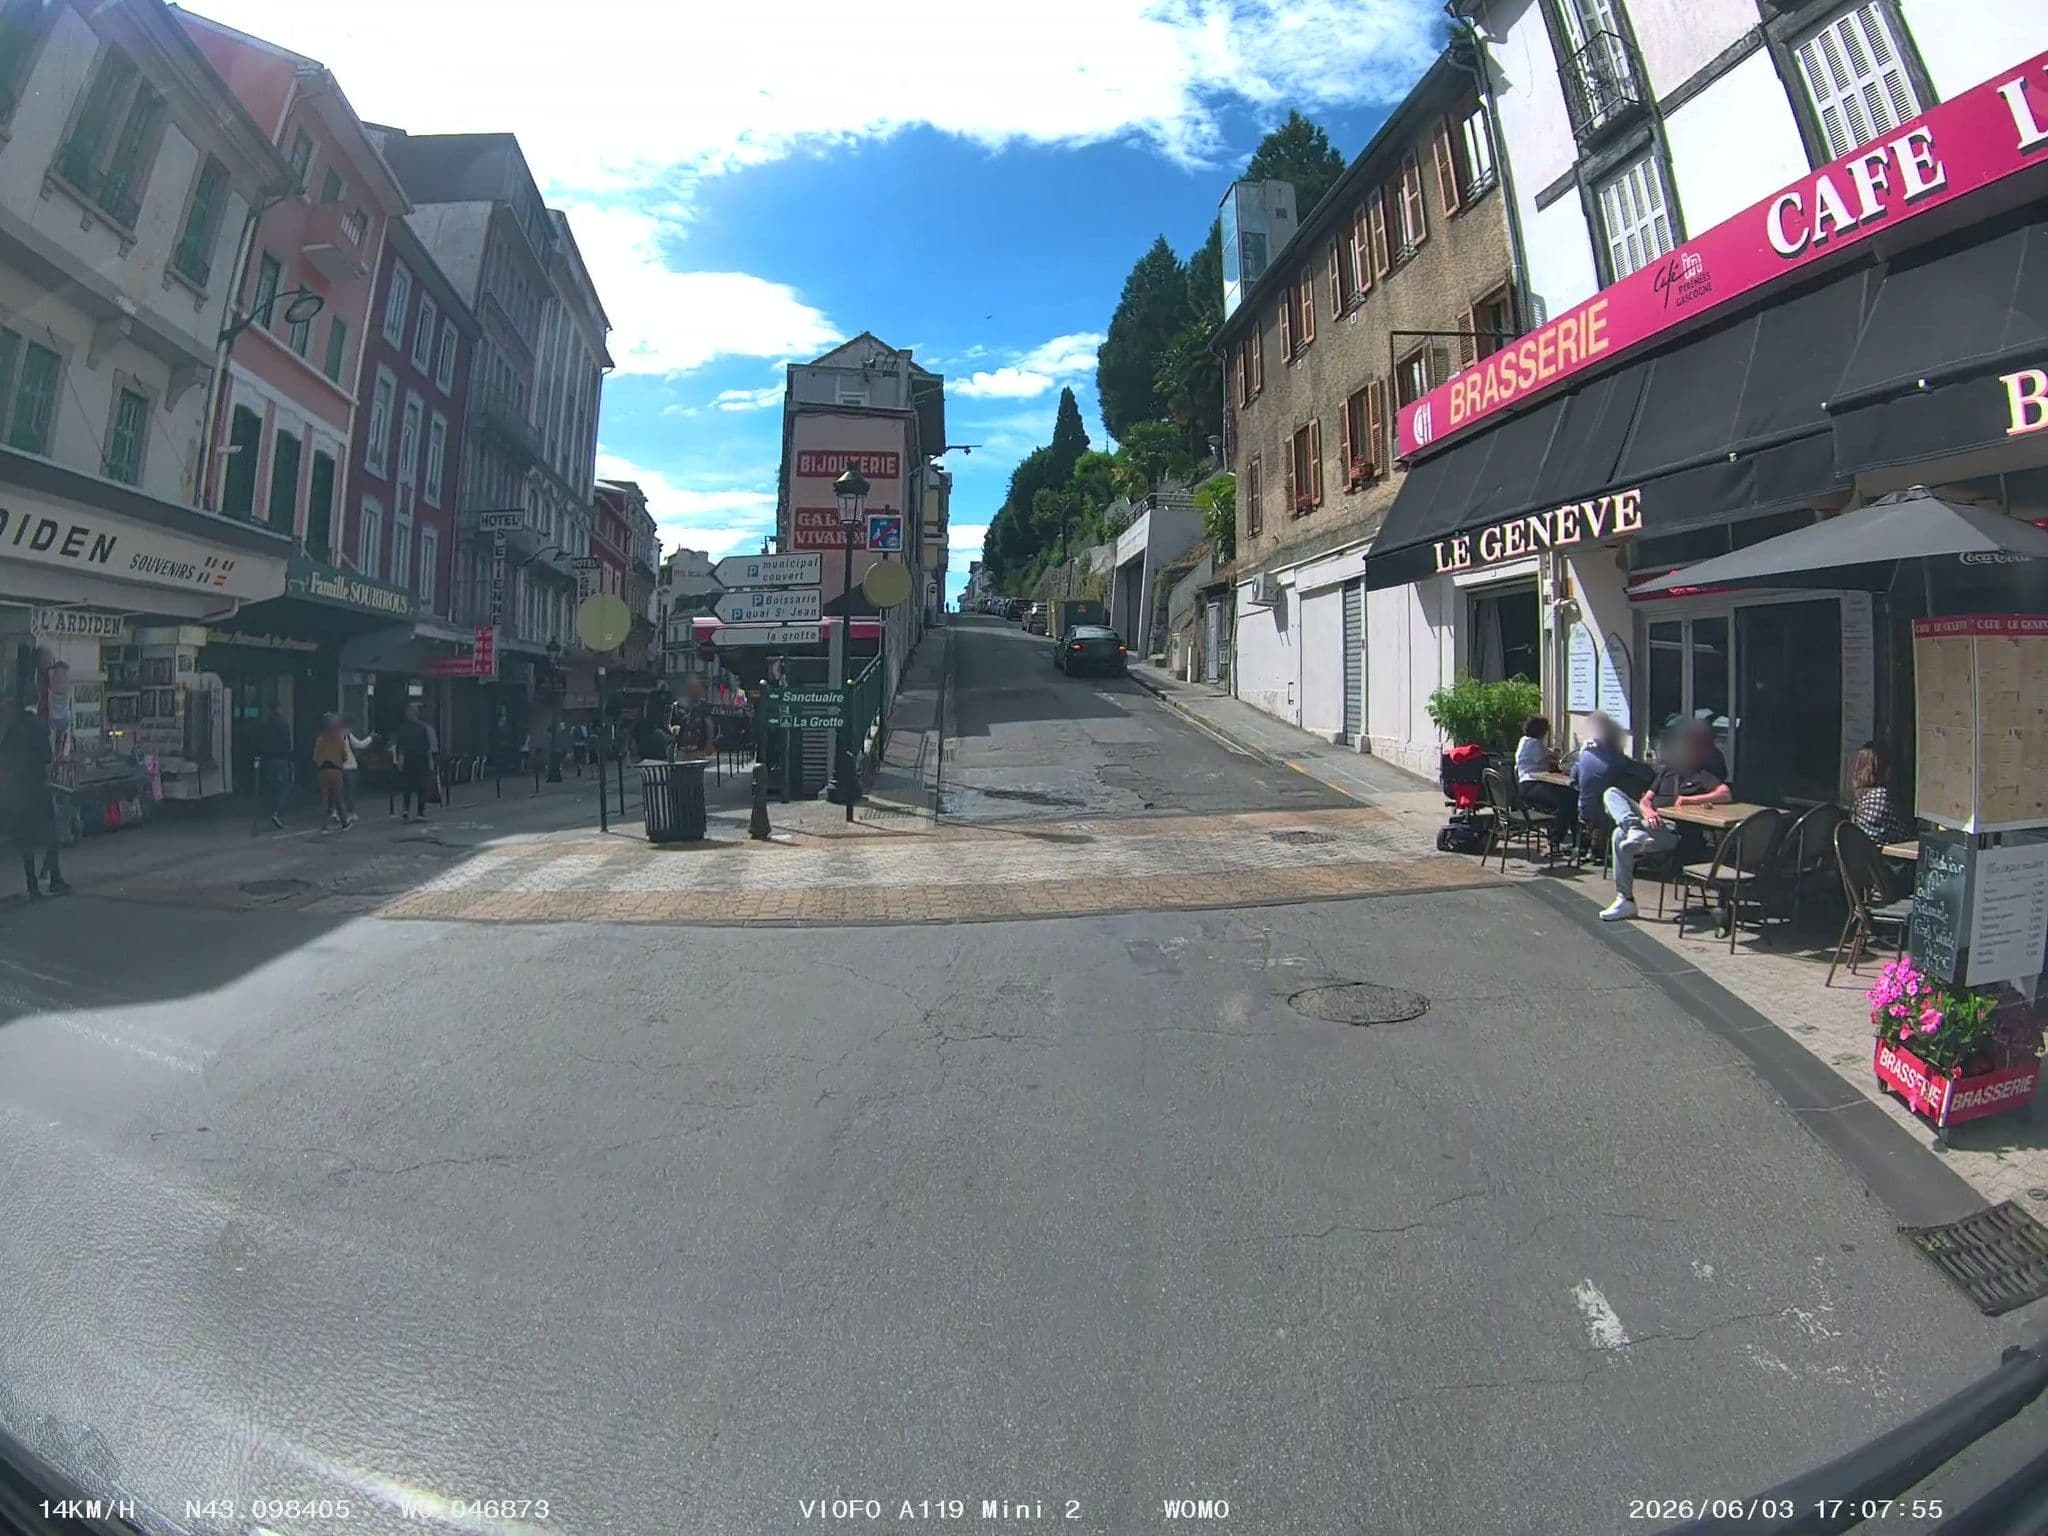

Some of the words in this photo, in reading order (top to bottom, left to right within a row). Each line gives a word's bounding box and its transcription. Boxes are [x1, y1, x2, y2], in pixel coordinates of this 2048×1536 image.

[1766, 124, 1947, 256] CAFE
[1997, 63, 2048, 151] L
[1450, 298, 1609, 425] BRASSERIE
[481, 514, 518, 527] HOTEL
[1434, 535, 1471, 573] LE
[130, 553, 196, 580] SOUVENIRS
[762, 557, 818, 572] municipal
[762, 571, 803, 582] couvert
[310, 571, 349, 598] Famille
[350, 581, 409, 614] SOUBIROUS
[766, 594, 817, 605] Boissarie
[746, 609, 770, 620] quai
[790, 608, 817, 617] Jean
[767, 631, 776, 641] la
[782, 630, 817, 642] grotte
[782, 691, 844, 703] Sanctuaire
[793, 716, 807, 727] La
[810, 716, 844, 727] Grotte
[1951, 1075, 2036, 1112] BRASSERIE
